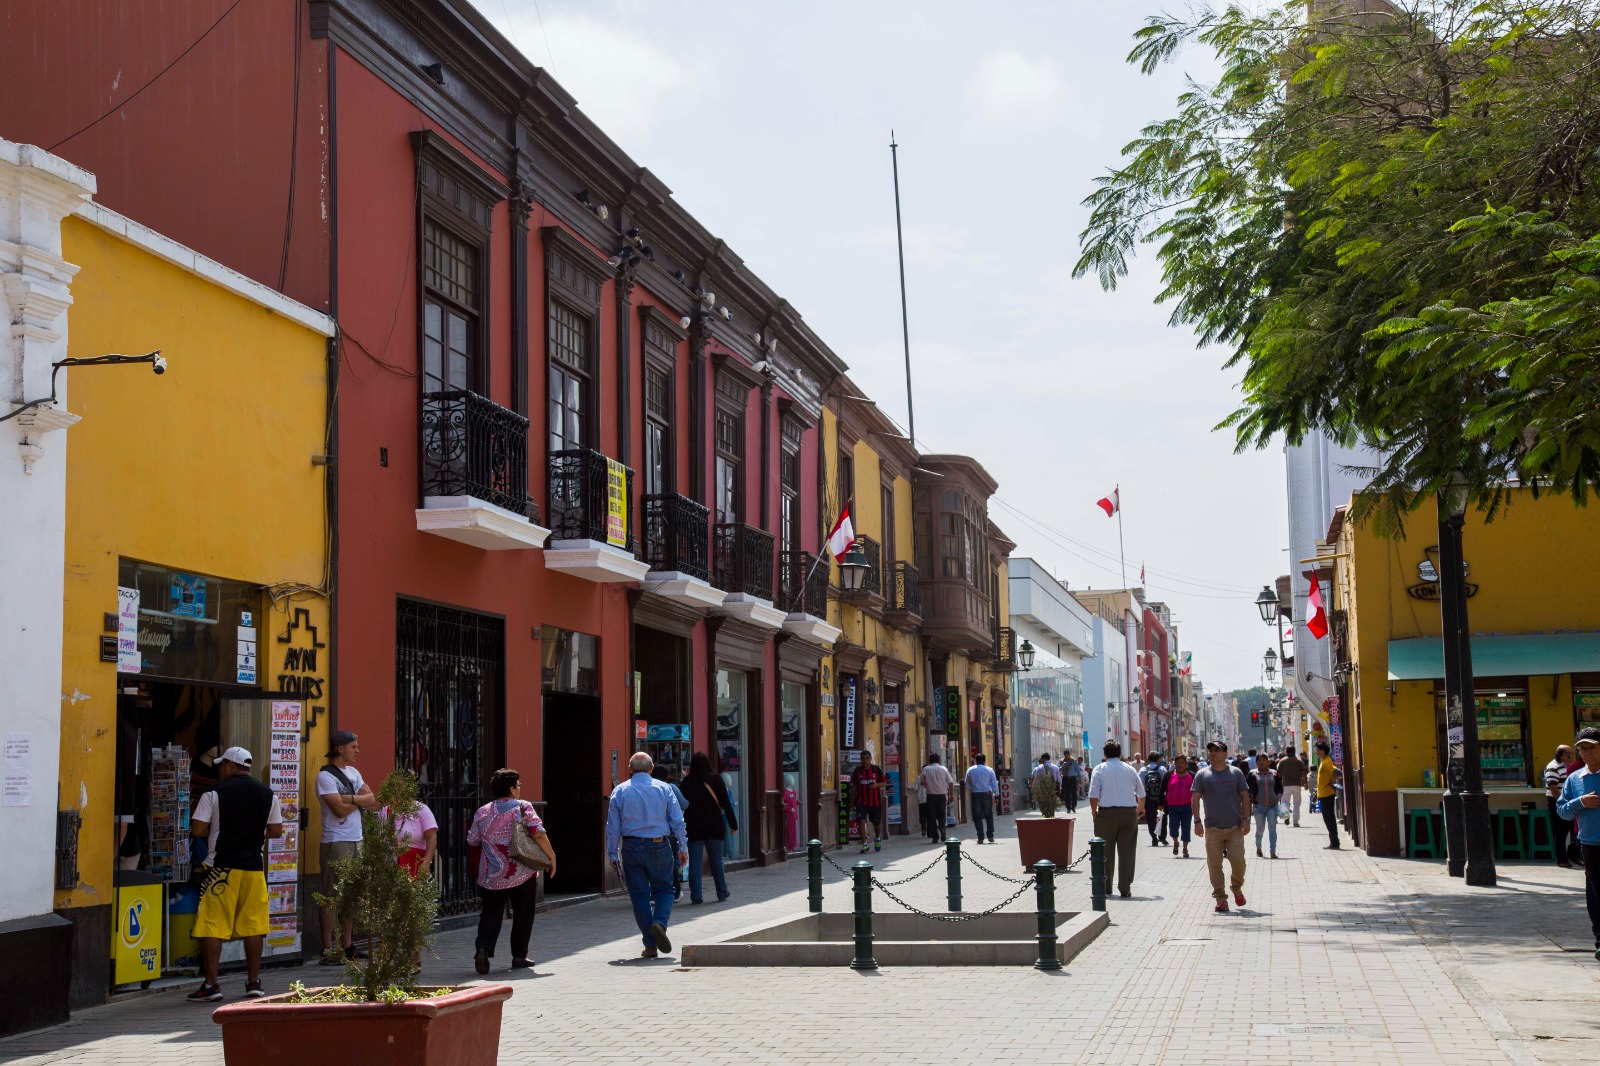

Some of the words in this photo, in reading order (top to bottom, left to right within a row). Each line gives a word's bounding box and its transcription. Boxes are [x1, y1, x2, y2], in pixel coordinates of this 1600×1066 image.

[118, 589, 134, 599] TACA
[1414, 584, 1437, 597] CON
[119, 638, 135, 650] TAM
[284, 647, 317, 673] AYNI
[278, 674, 325, 700] TOURS
[948, 692, 959, 734] ORO
[280, 753, 297, 761] $439
[271, 777, 297, 785] PANAMA
[1001, 776, 1011, 814] TOURS
[839, 783, 848, 843] DOLARES
[140, 947, 158, 959] Cerca
[141, 956, 148, 965] de
[147, 956, 155, 971] ti
